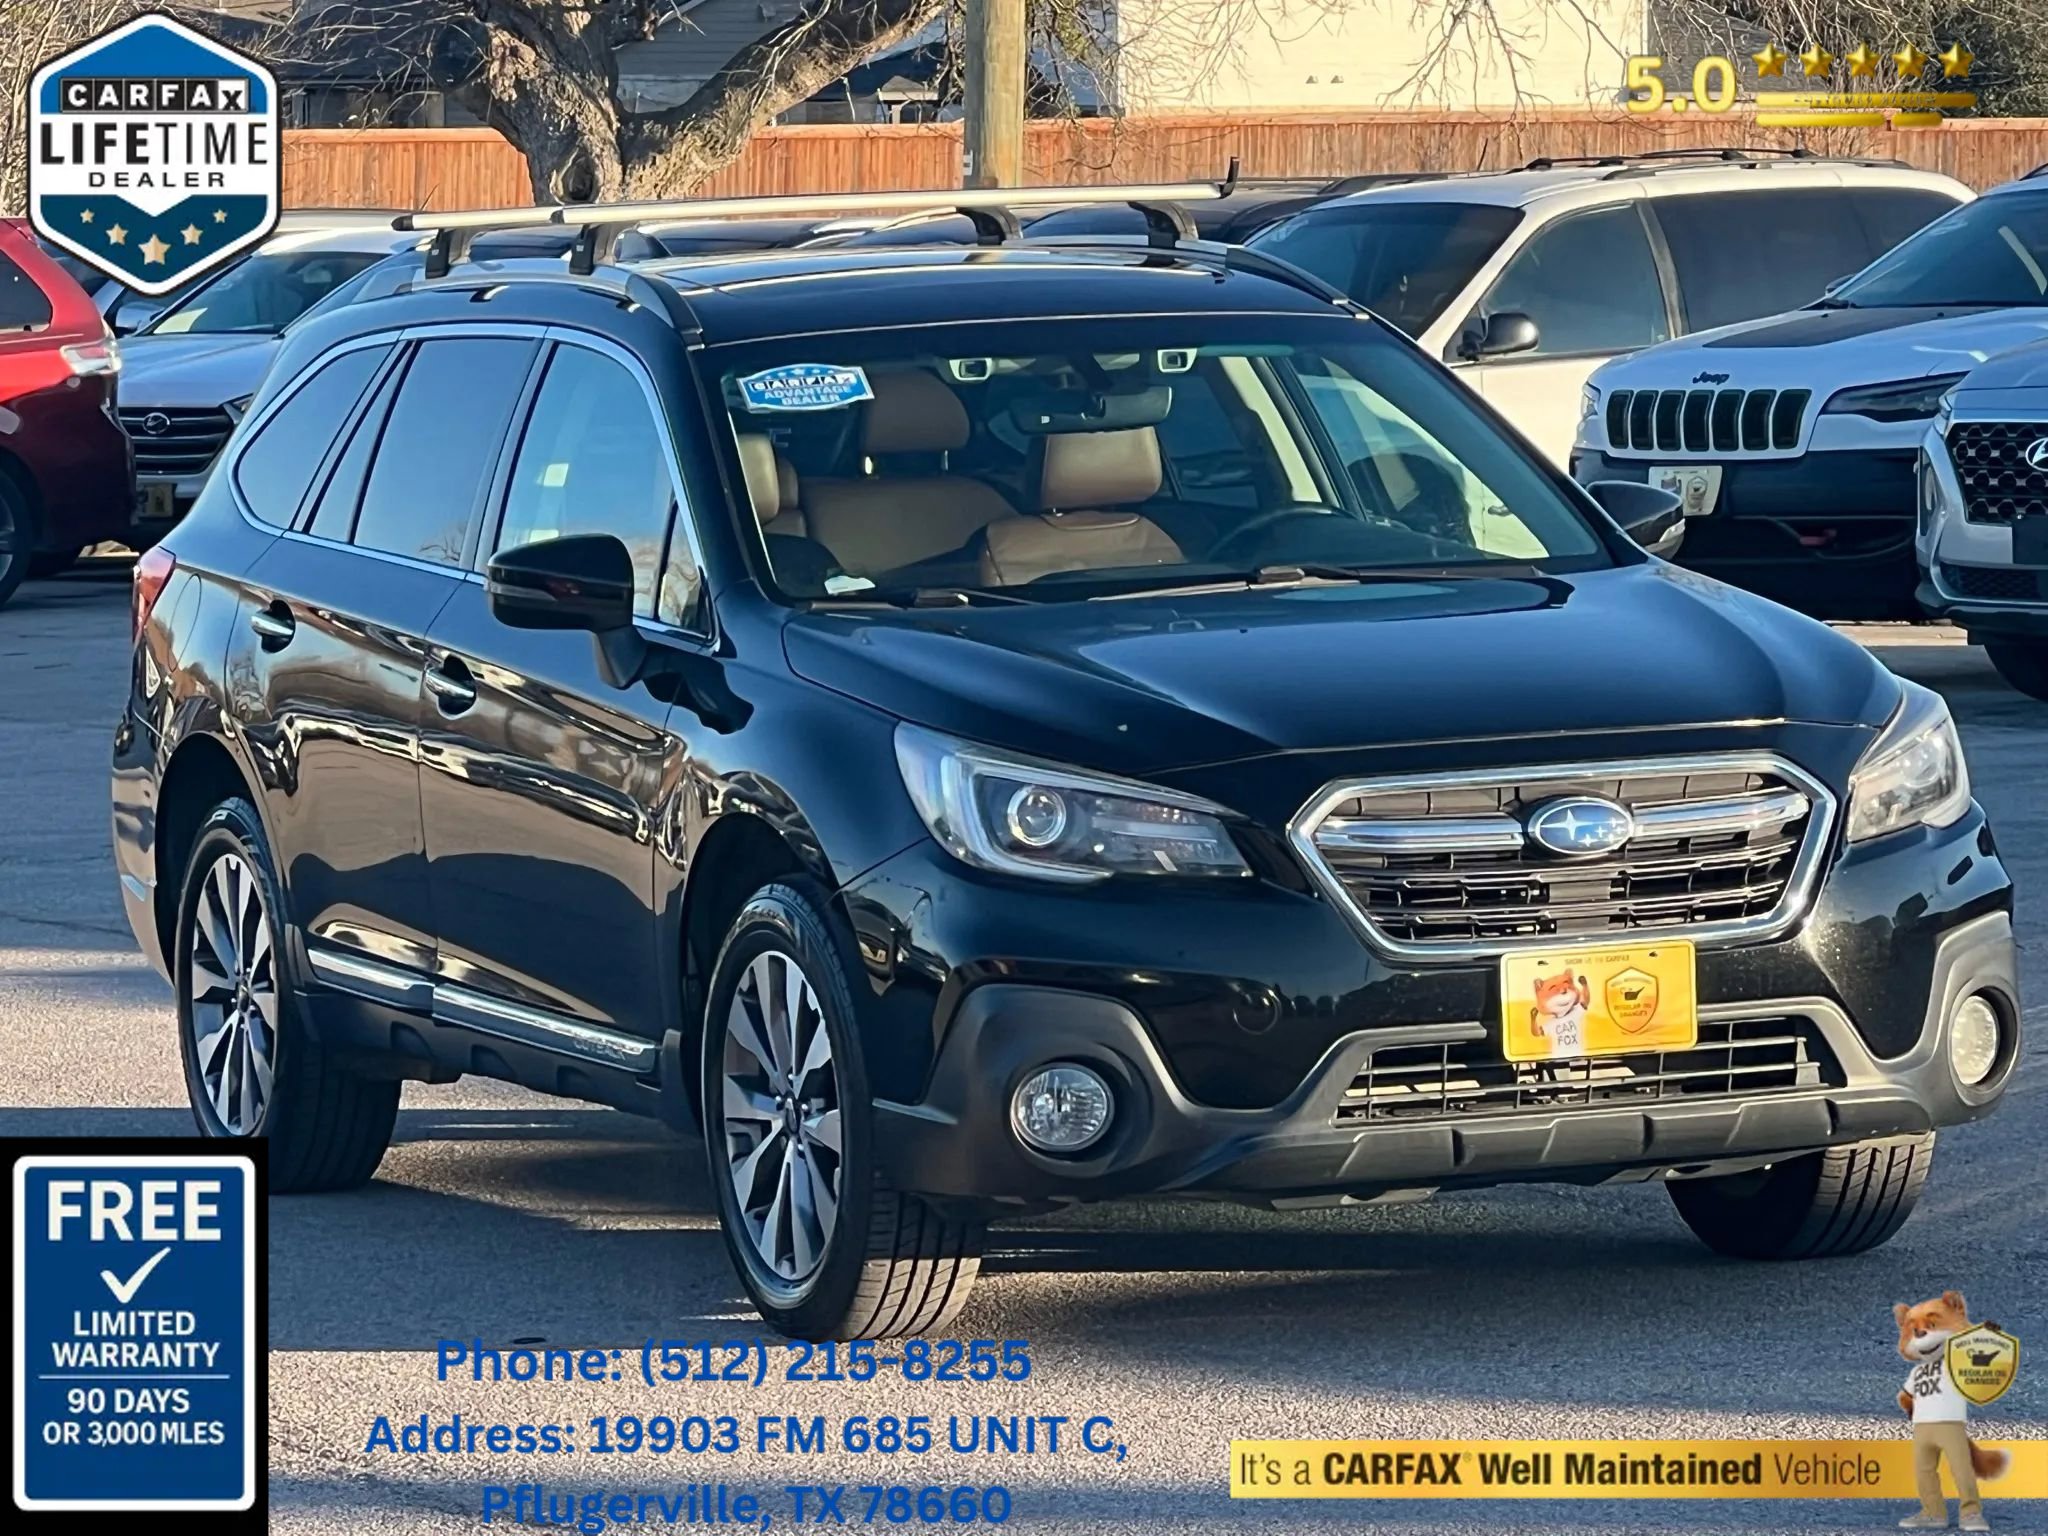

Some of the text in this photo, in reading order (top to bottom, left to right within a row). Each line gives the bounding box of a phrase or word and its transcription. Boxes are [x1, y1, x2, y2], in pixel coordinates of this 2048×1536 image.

[765, 384, 852, 400] ADVANTAGE
[781, 394, 841, 406] DEALER
[1555, 1020, 1577, 1035] CAR
[1557, 1034, 1578, 1047] FOX
